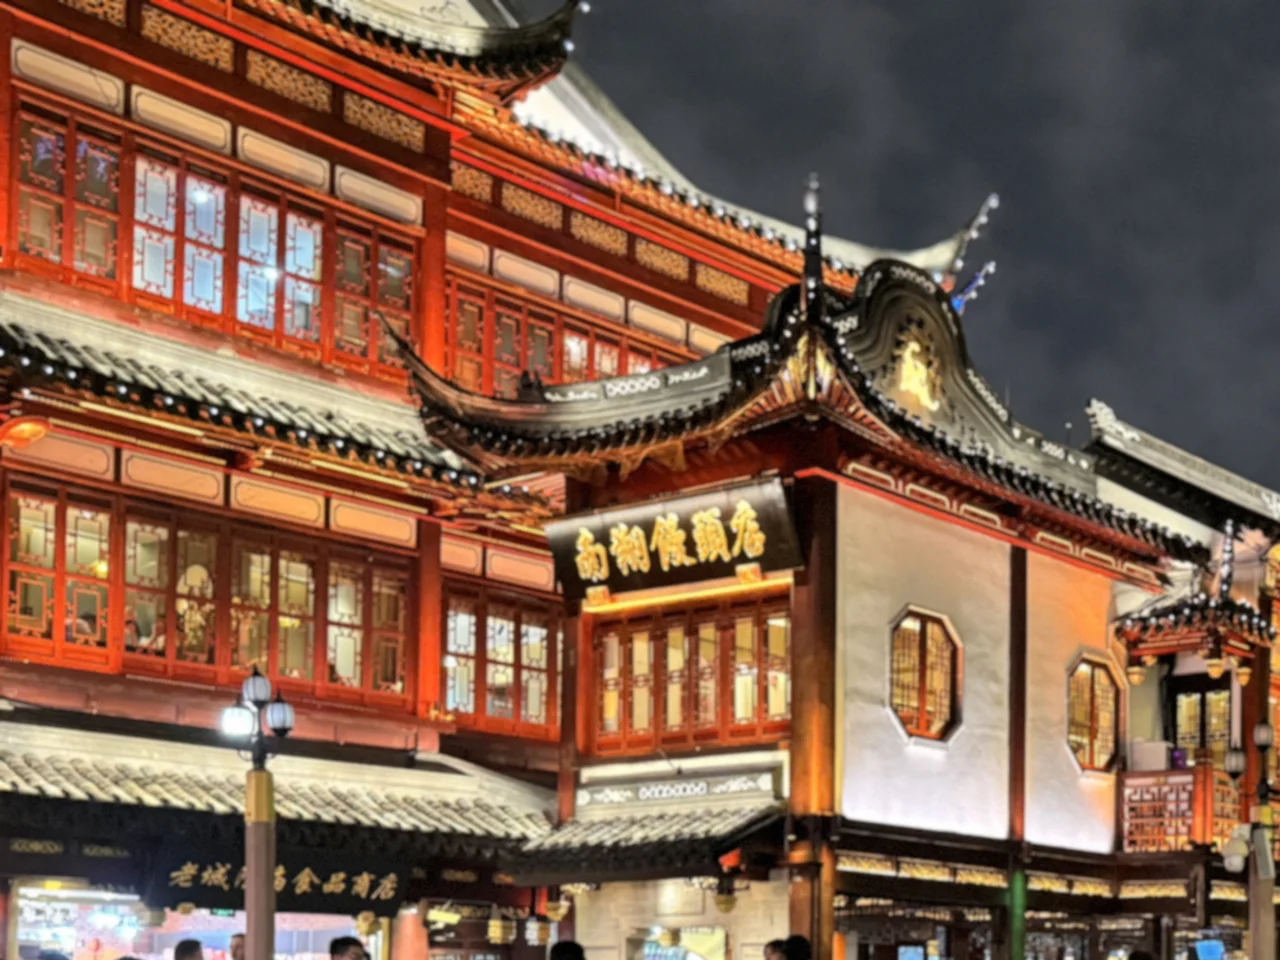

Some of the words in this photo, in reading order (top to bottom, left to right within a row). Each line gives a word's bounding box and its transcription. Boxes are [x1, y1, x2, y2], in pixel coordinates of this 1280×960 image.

[575, 499, 766, 582] 南翔饅頭店
